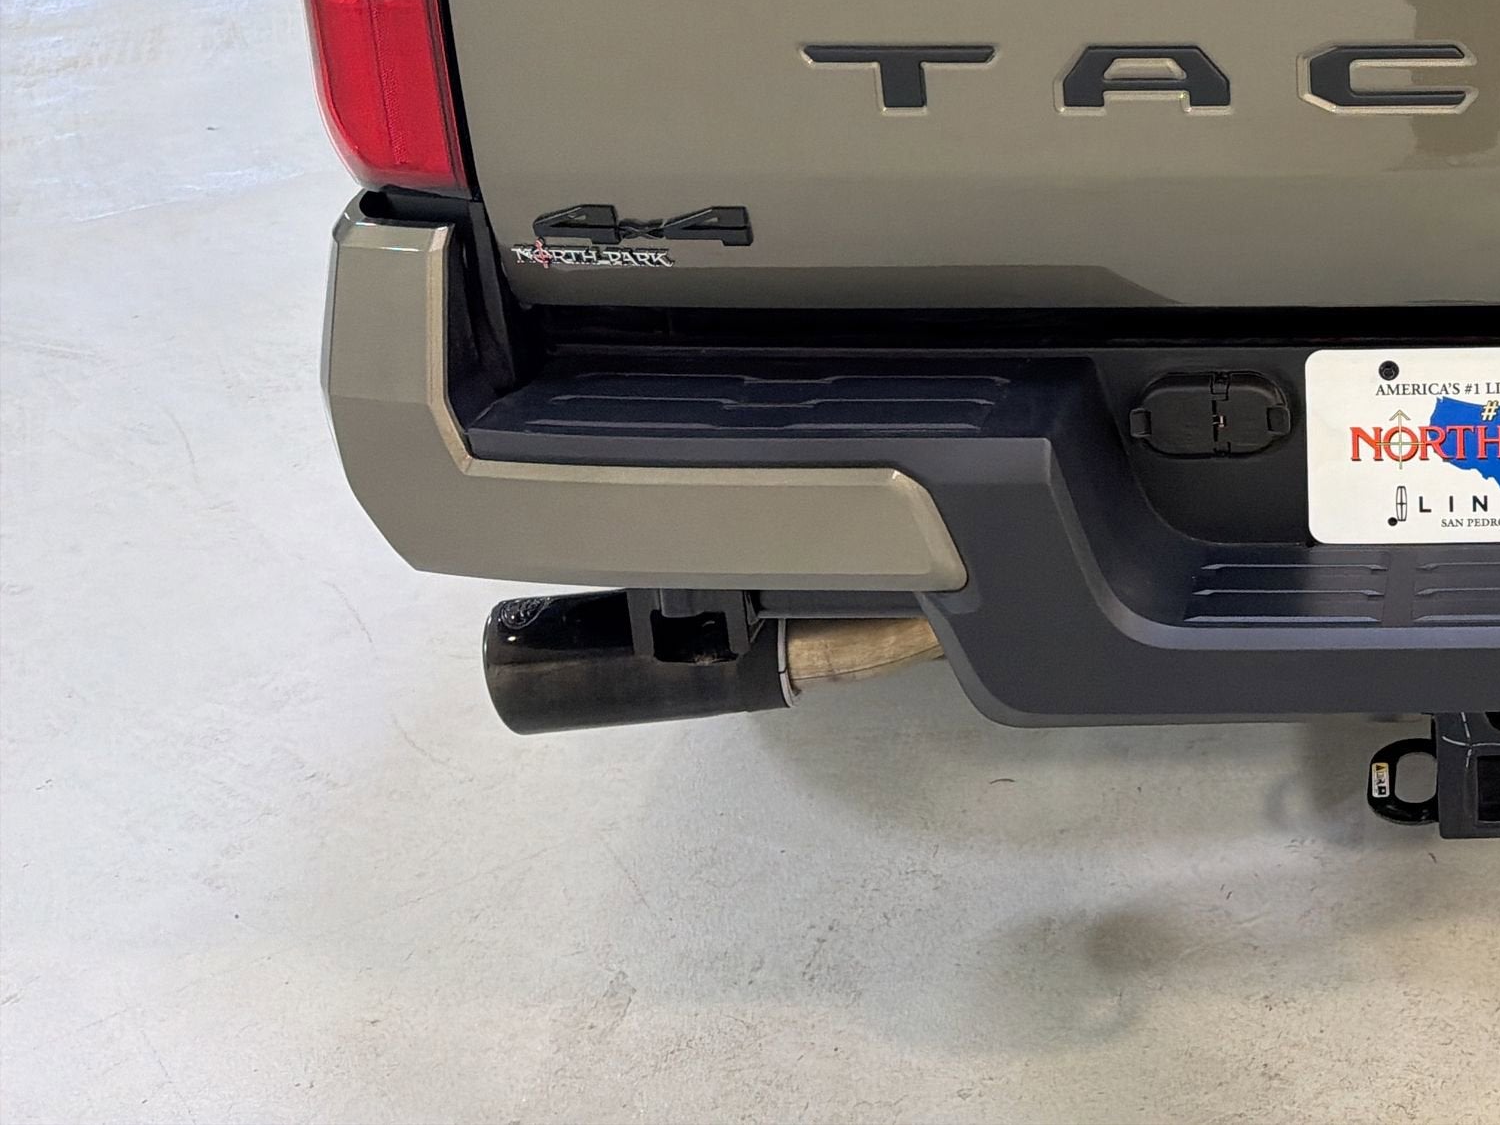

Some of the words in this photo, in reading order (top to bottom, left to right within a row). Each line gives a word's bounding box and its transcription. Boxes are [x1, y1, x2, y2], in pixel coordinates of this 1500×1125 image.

[511, 245, 597, 266] NORTH
[602, 247, 675, 267] PARK
[1376, 382, 1460, 396] AMERICA'S
[1464, 382, 1481, 395] #1
[1441, 518, 1464, 527] SAN
